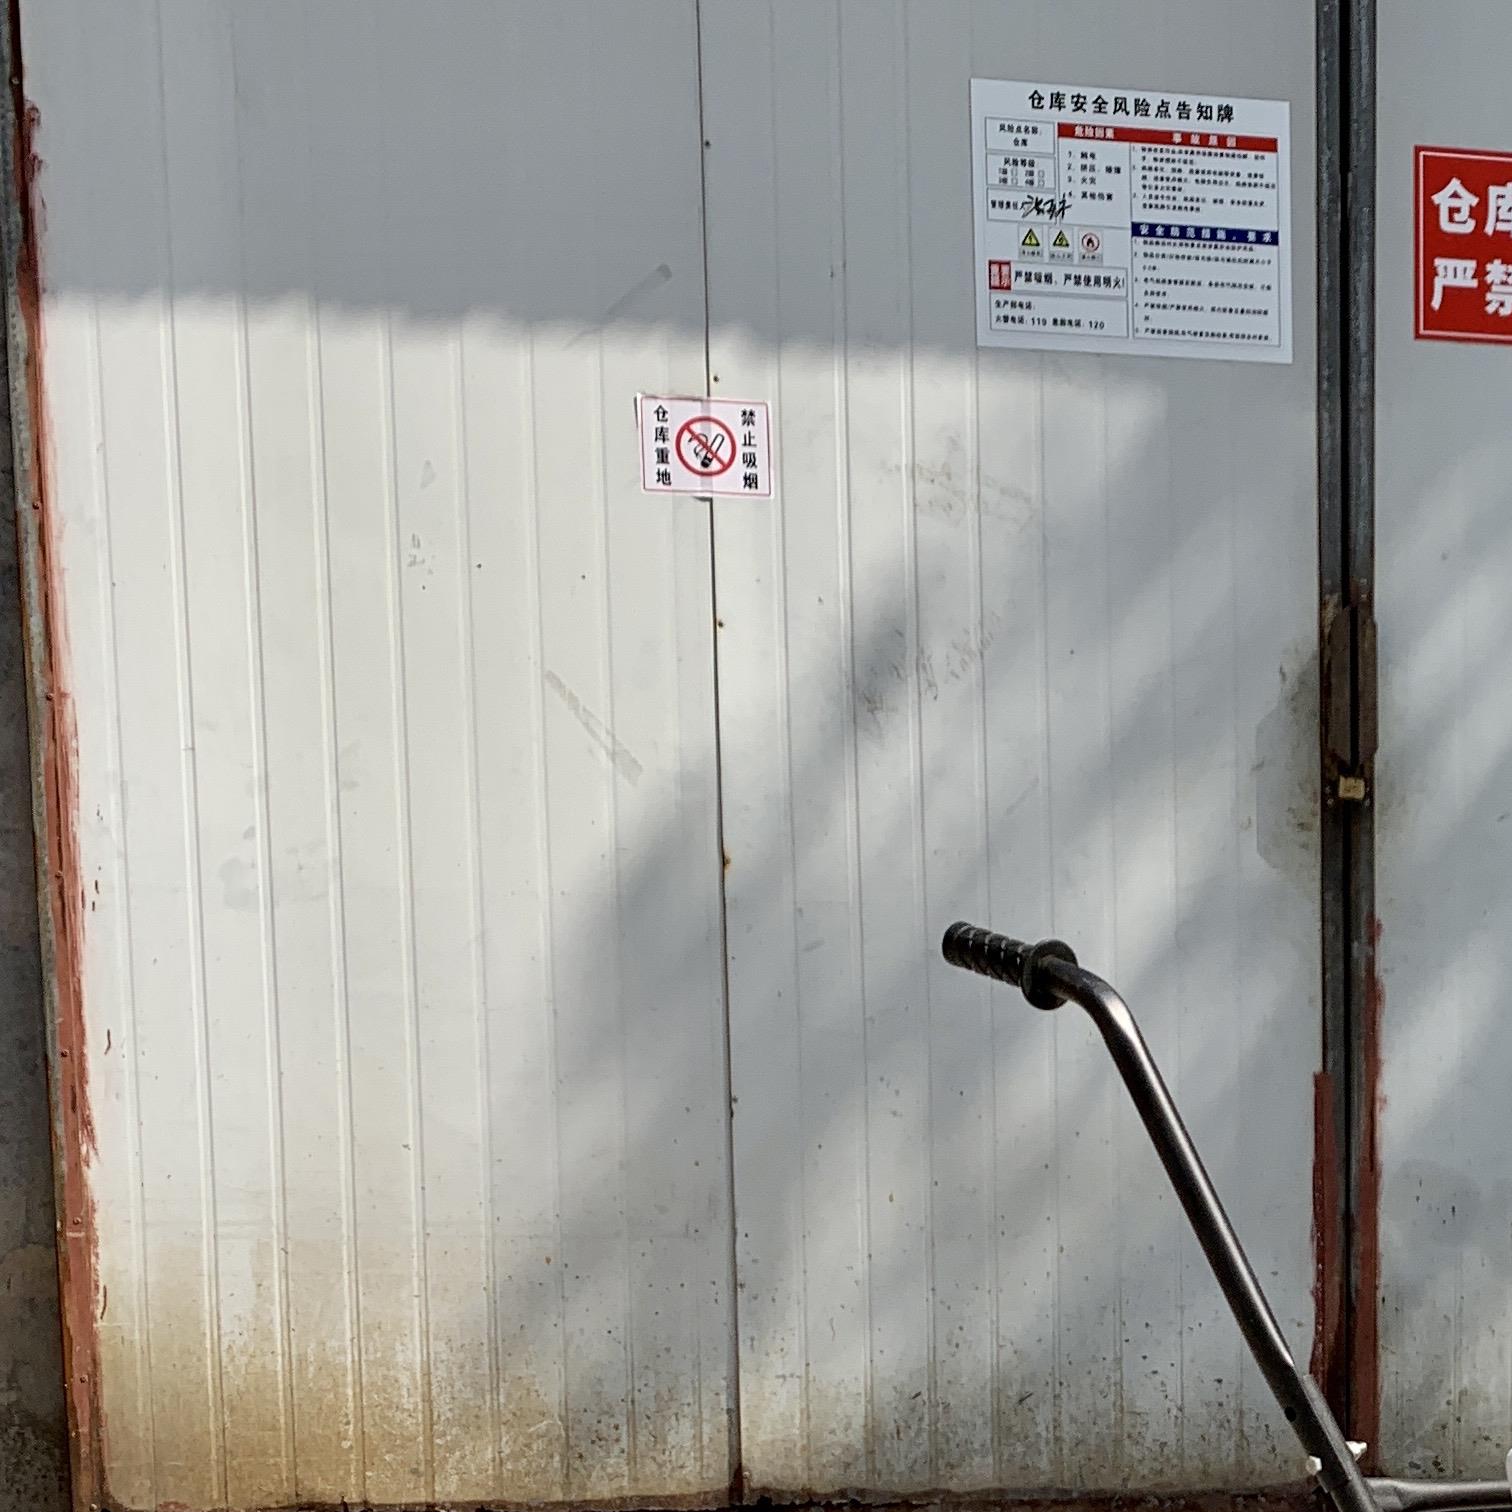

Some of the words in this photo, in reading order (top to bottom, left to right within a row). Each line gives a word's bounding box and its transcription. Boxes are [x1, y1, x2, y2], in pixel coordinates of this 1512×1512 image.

[1028, 89, 1235, 124] 仓库安全风险点告知牌
[653, 404, 672, 486] 仓库重地
[741, 408, 759, 490] 禁止吸烟
